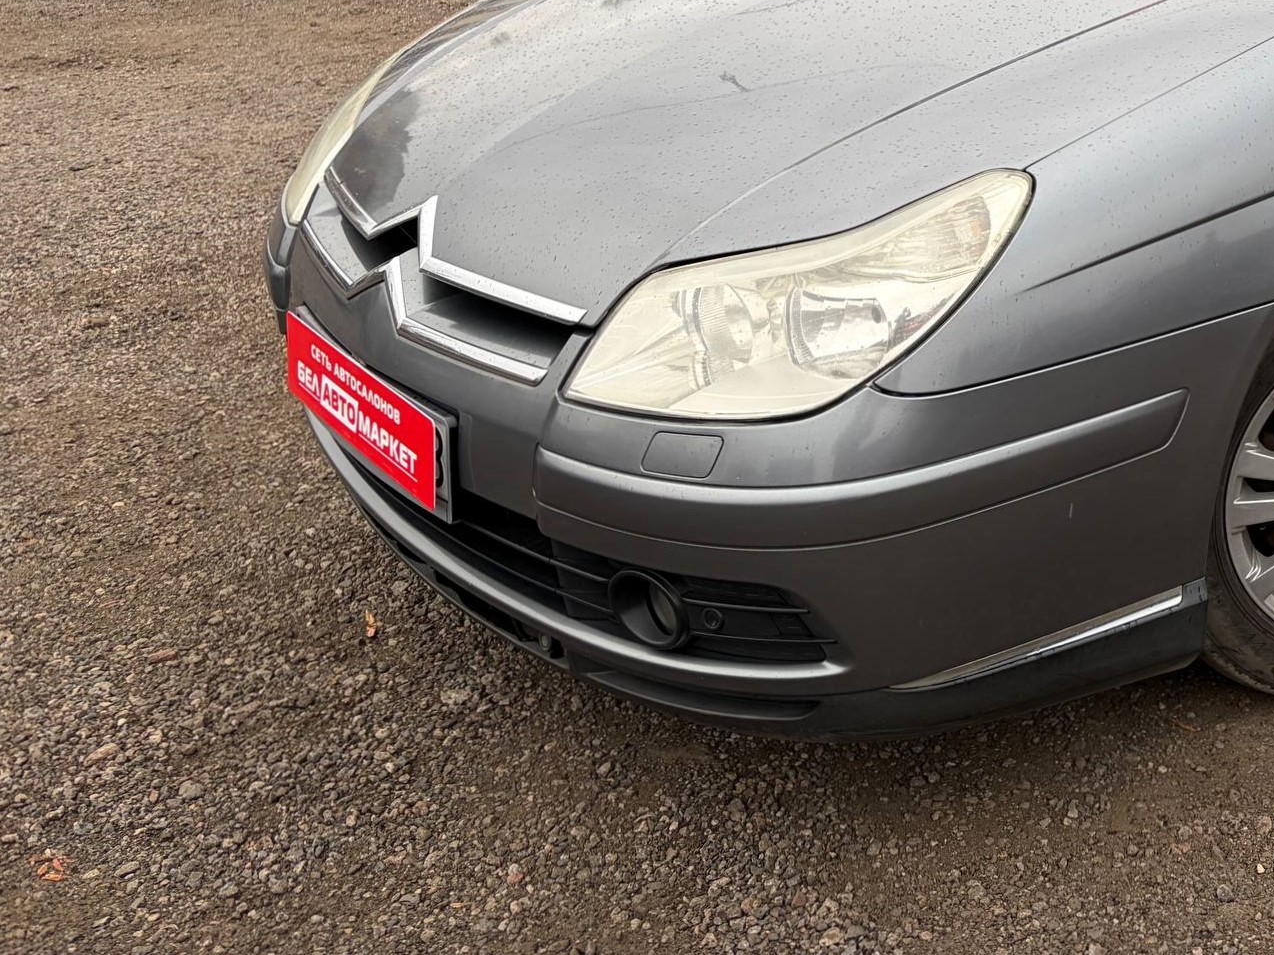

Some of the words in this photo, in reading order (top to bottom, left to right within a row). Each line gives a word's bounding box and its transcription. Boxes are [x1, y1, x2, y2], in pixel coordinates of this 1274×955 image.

[297, 360, 321, 396] БЕЛ
[323, 383, 358, 424] АВТО
[358, 411, 418, 474] МАРКЕТ
[310, 344, 332, 372] СЕТЬ
[333, 363, 401, 425] АВТОСАЛОНОВ
